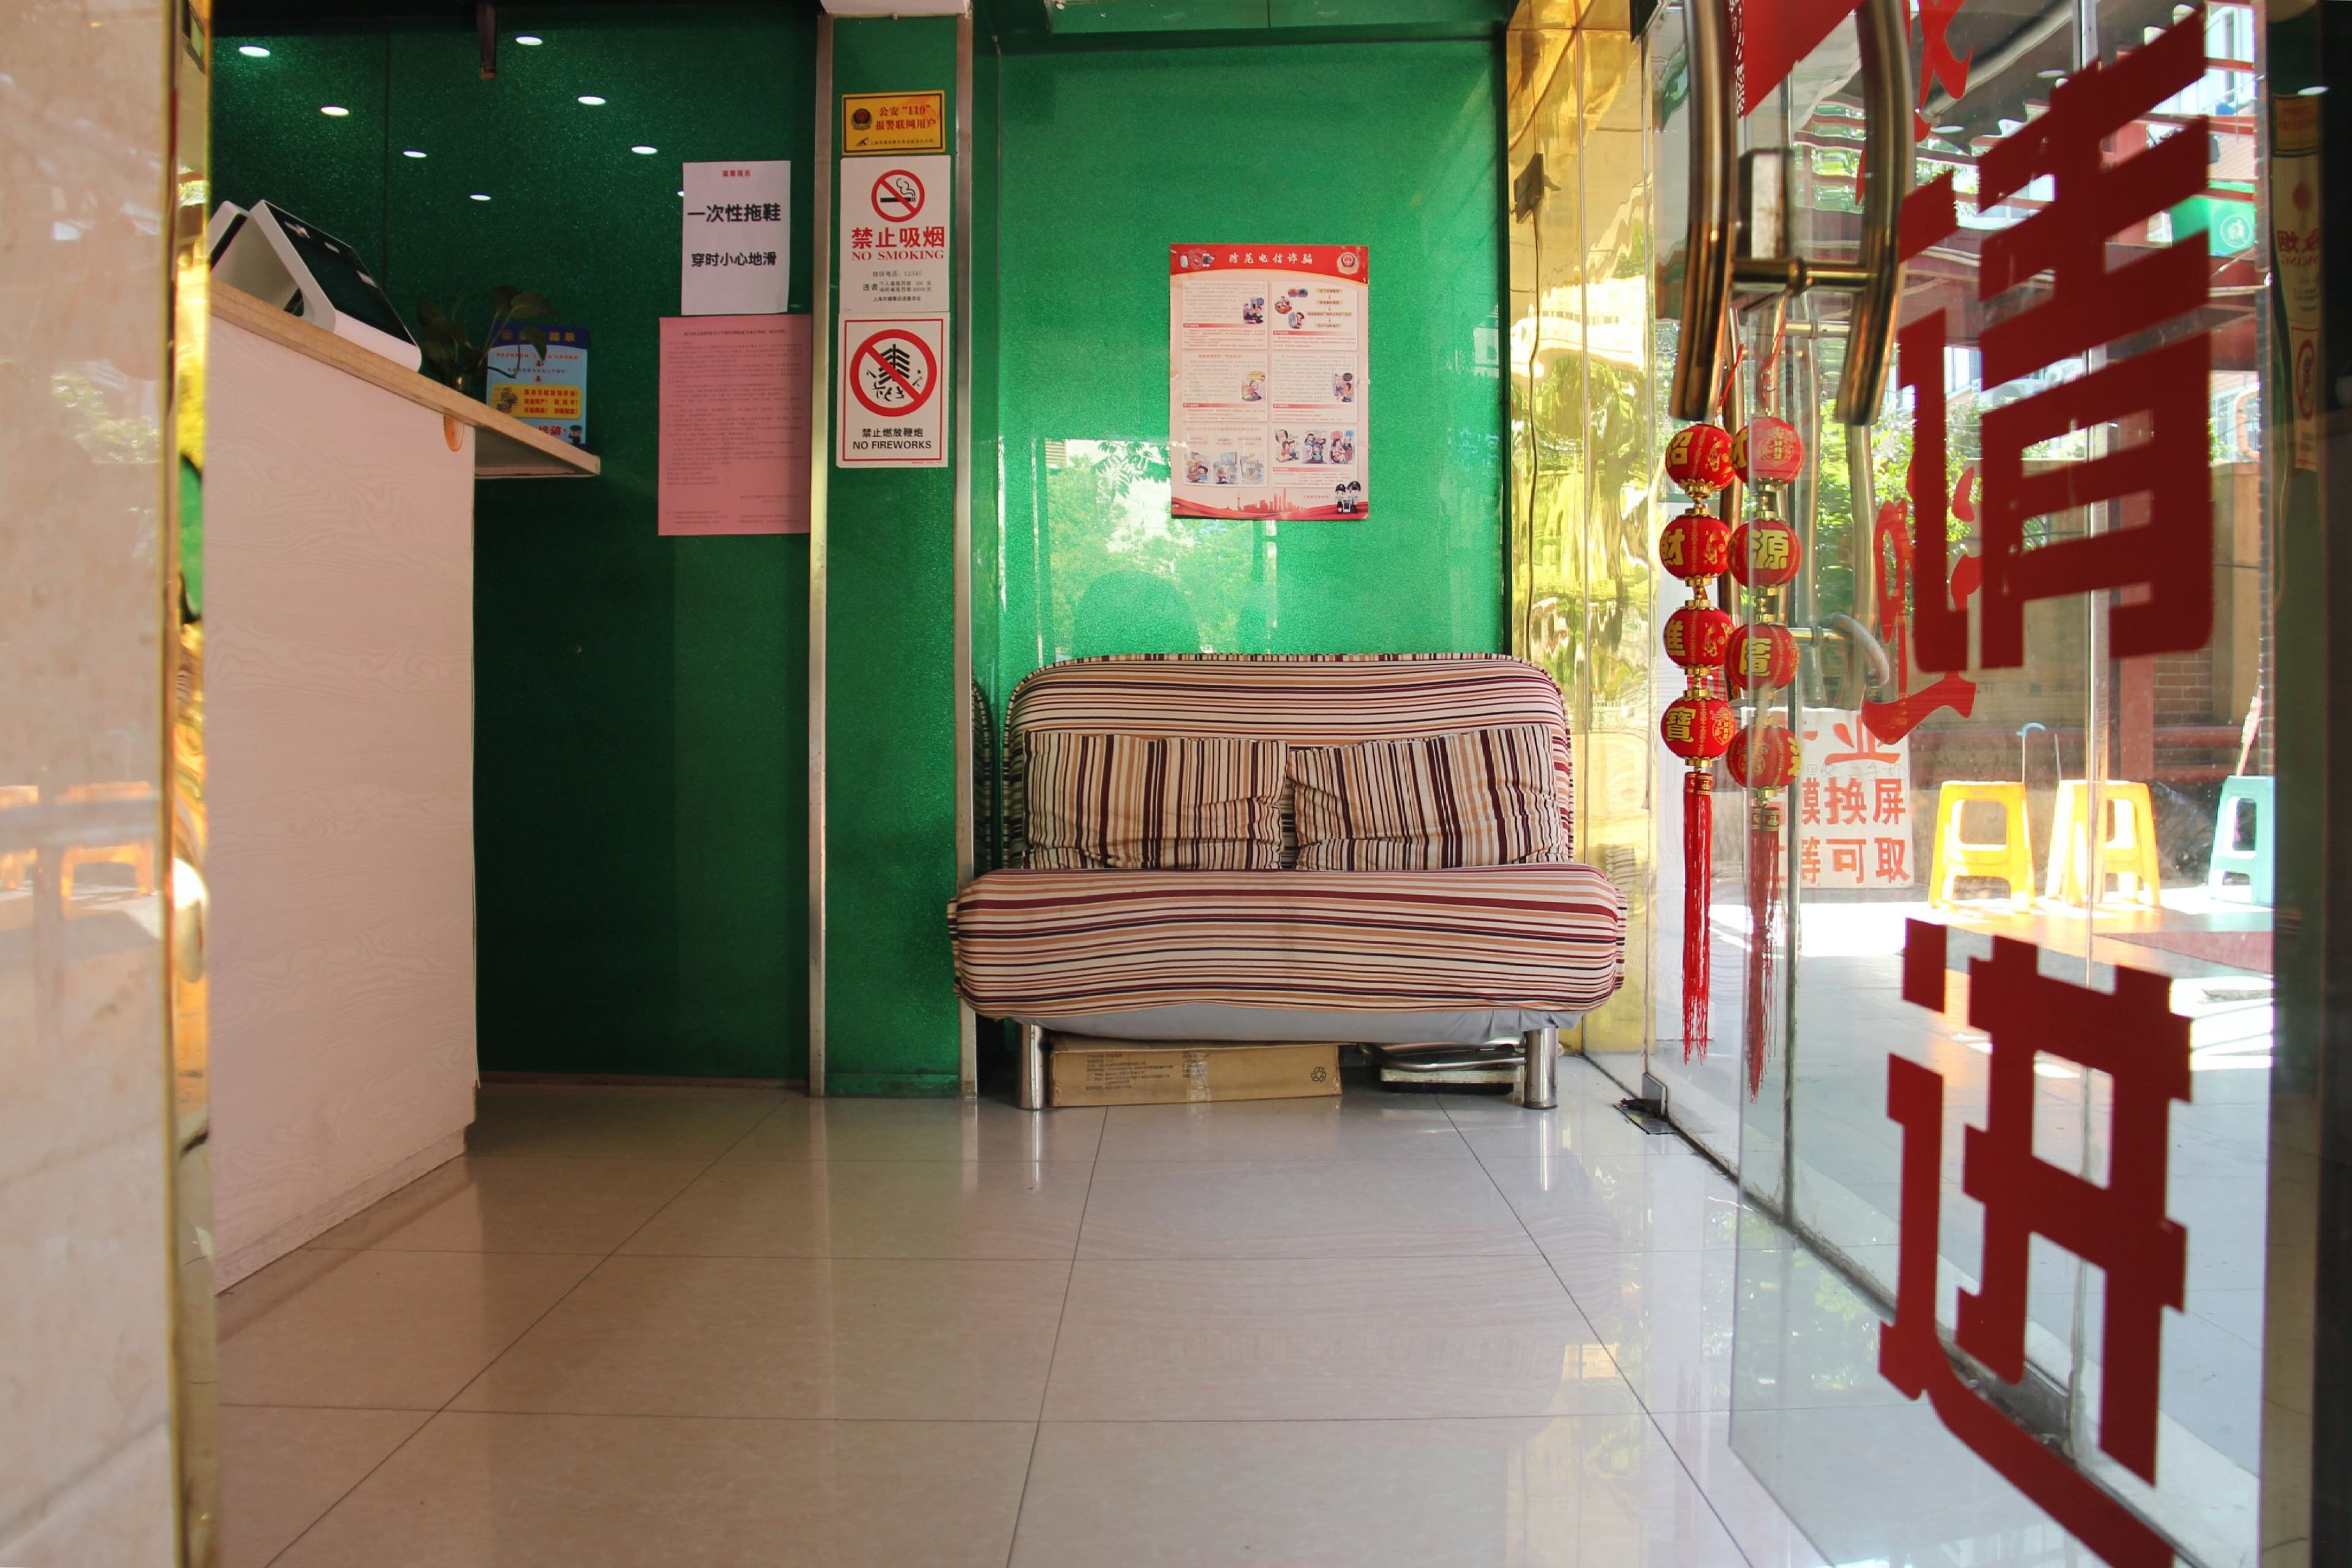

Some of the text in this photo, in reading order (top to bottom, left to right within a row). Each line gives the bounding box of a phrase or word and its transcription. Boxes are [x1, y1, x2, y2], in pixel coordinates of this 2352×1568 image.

[876, 118, 937, 130] 报警联网用户
[687, 203, 782, 222] 一次性拖鞋
[851, 226, 945, 249] 禁止吸烟
[691, 252, 777, 267] 穿时小心地滑
[852, 250, 944, 261] NO SMOKING
[1229, 252, 1313, 265] 防范电信诈骗
[862, 428, 924, 438] 禁止燃放鞭炮
[853, 440, 932, 450] NO FIREWORKS
